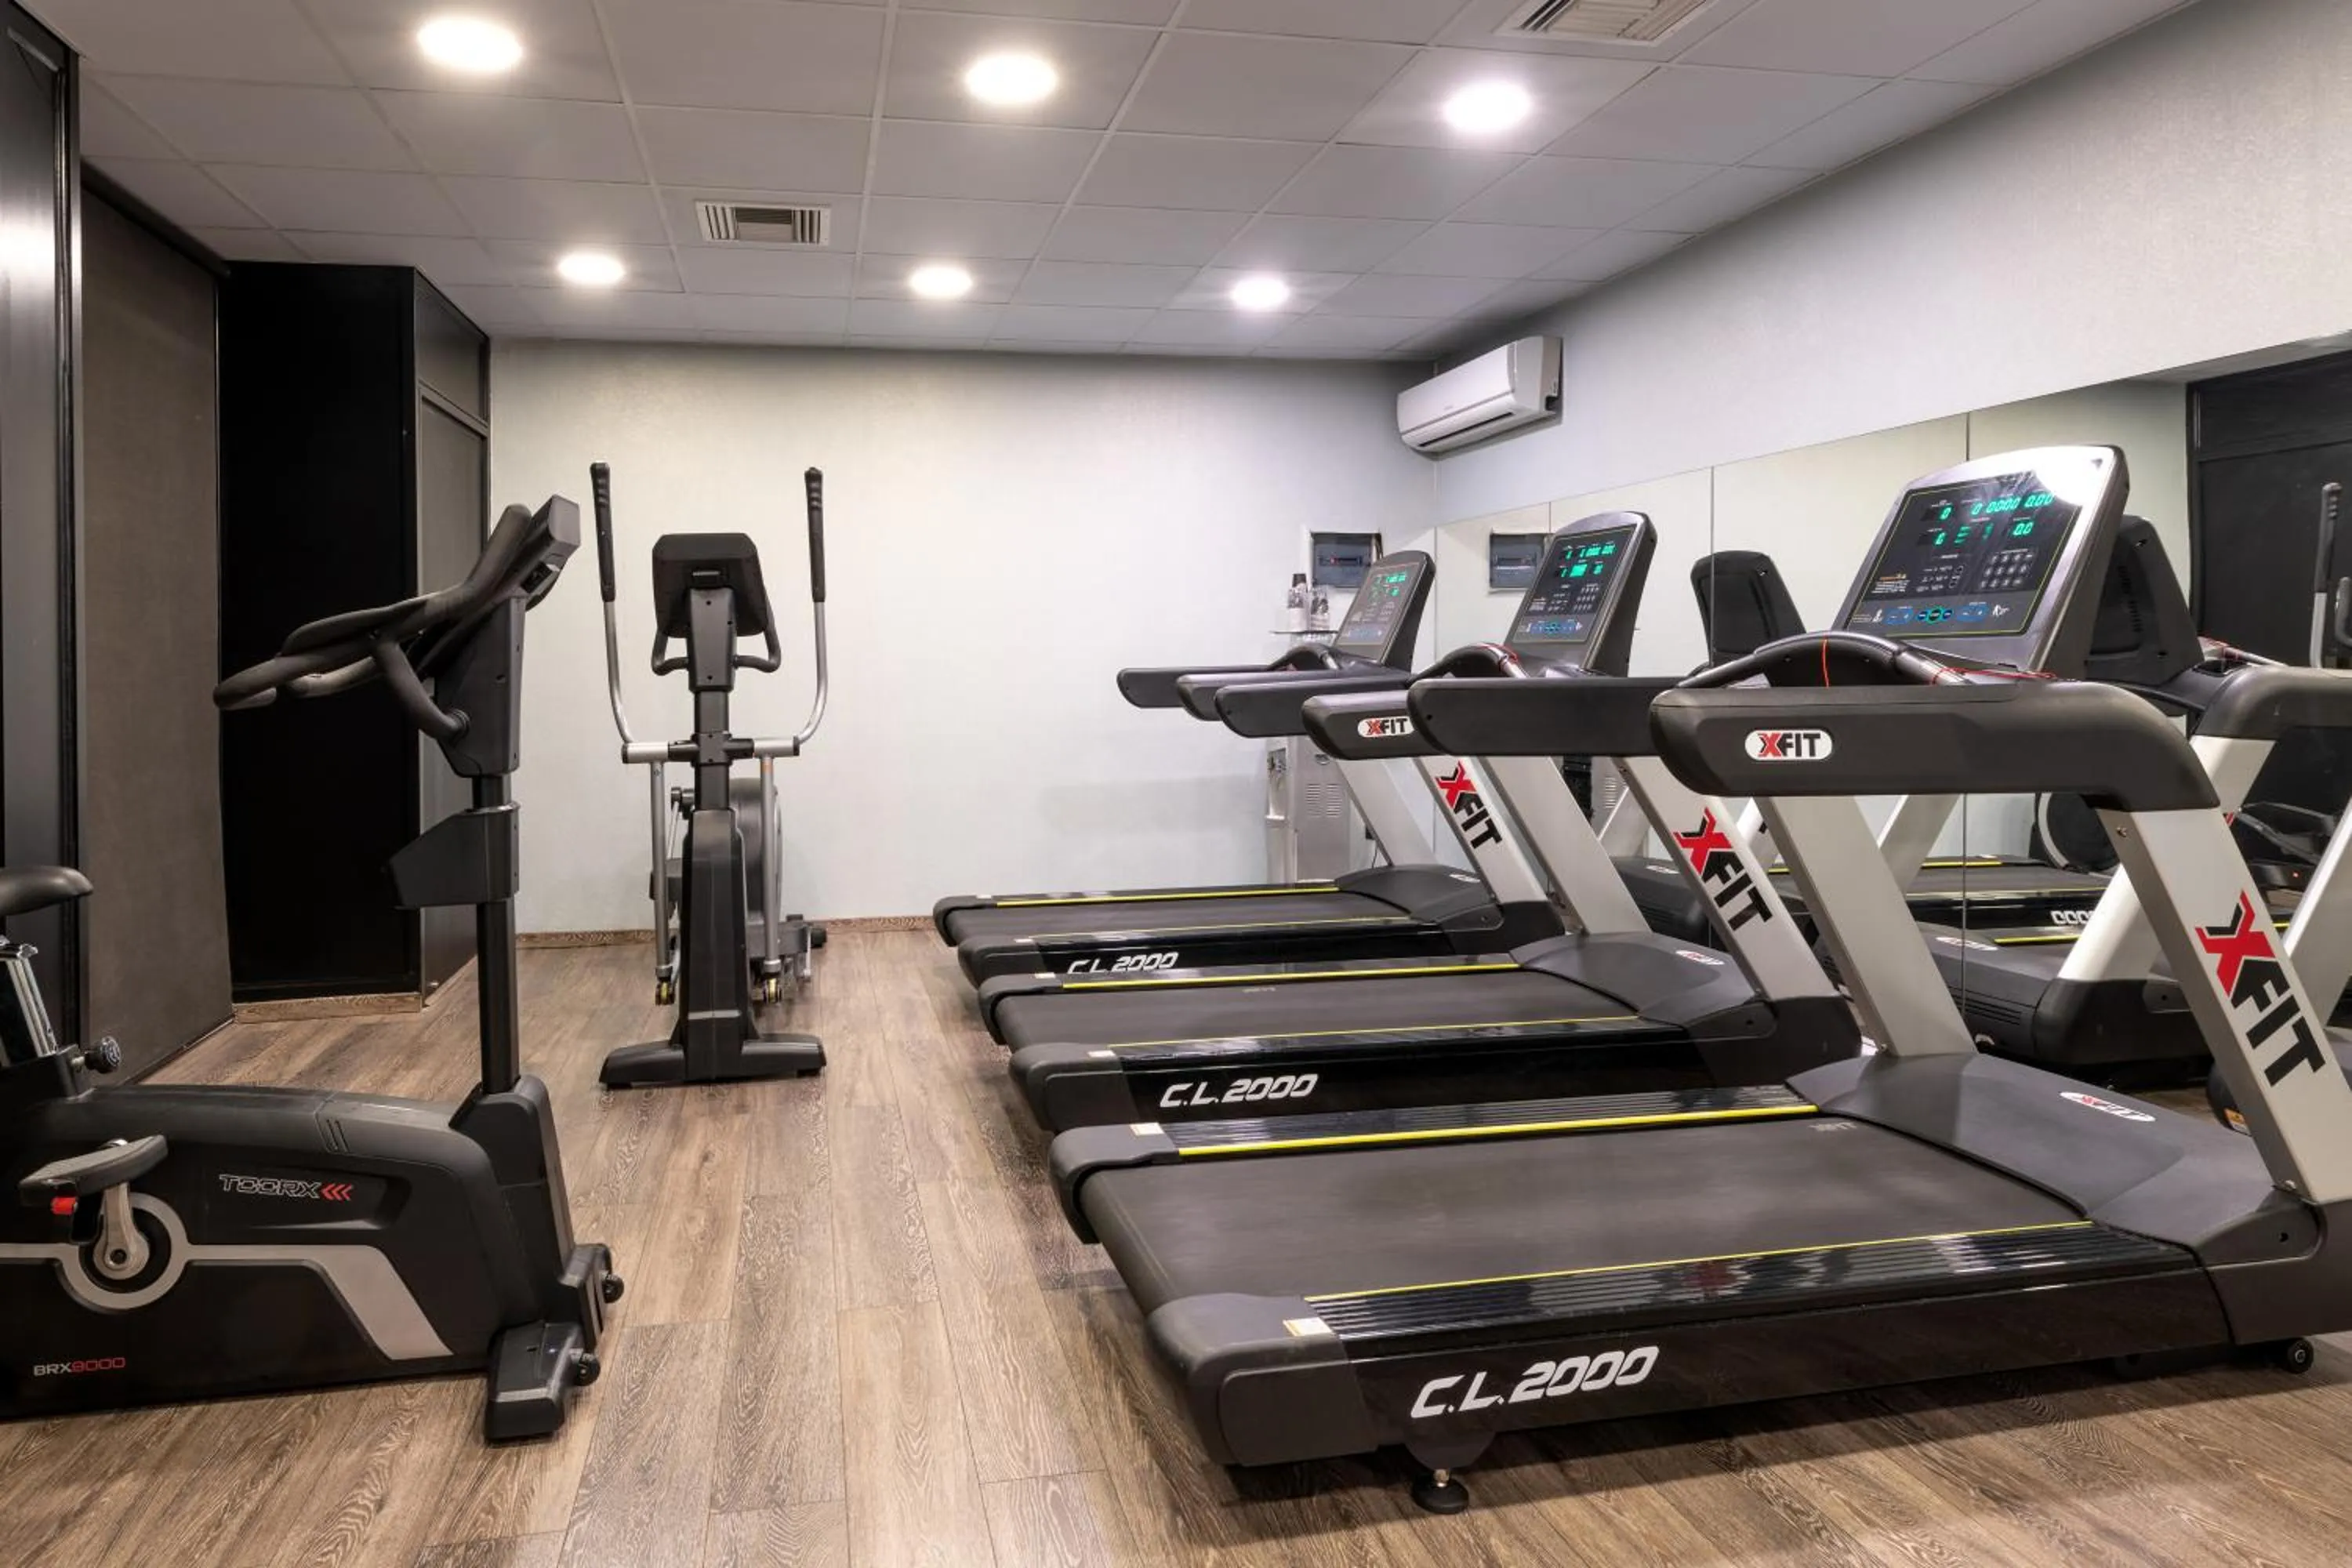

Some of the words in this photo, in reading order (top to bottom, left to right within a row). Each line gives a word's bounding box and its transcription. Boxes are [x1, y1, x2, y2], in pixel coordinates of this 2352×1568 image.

[1366, 718, 1408, 735] XFIT
[1758, 732, 1821, 758] XFIT
[1436, 760, 1503, 849] XFIT
[1673, 806, 1773, 932] XFIT
[2194, 889, 2326, 1087] XFIT
[1160, 1073, 1319, 1109] C.L.2000
[219, 1174, 322, 1200] TOORX
[1411, 1345, 1661, 1418] C.L.2000
